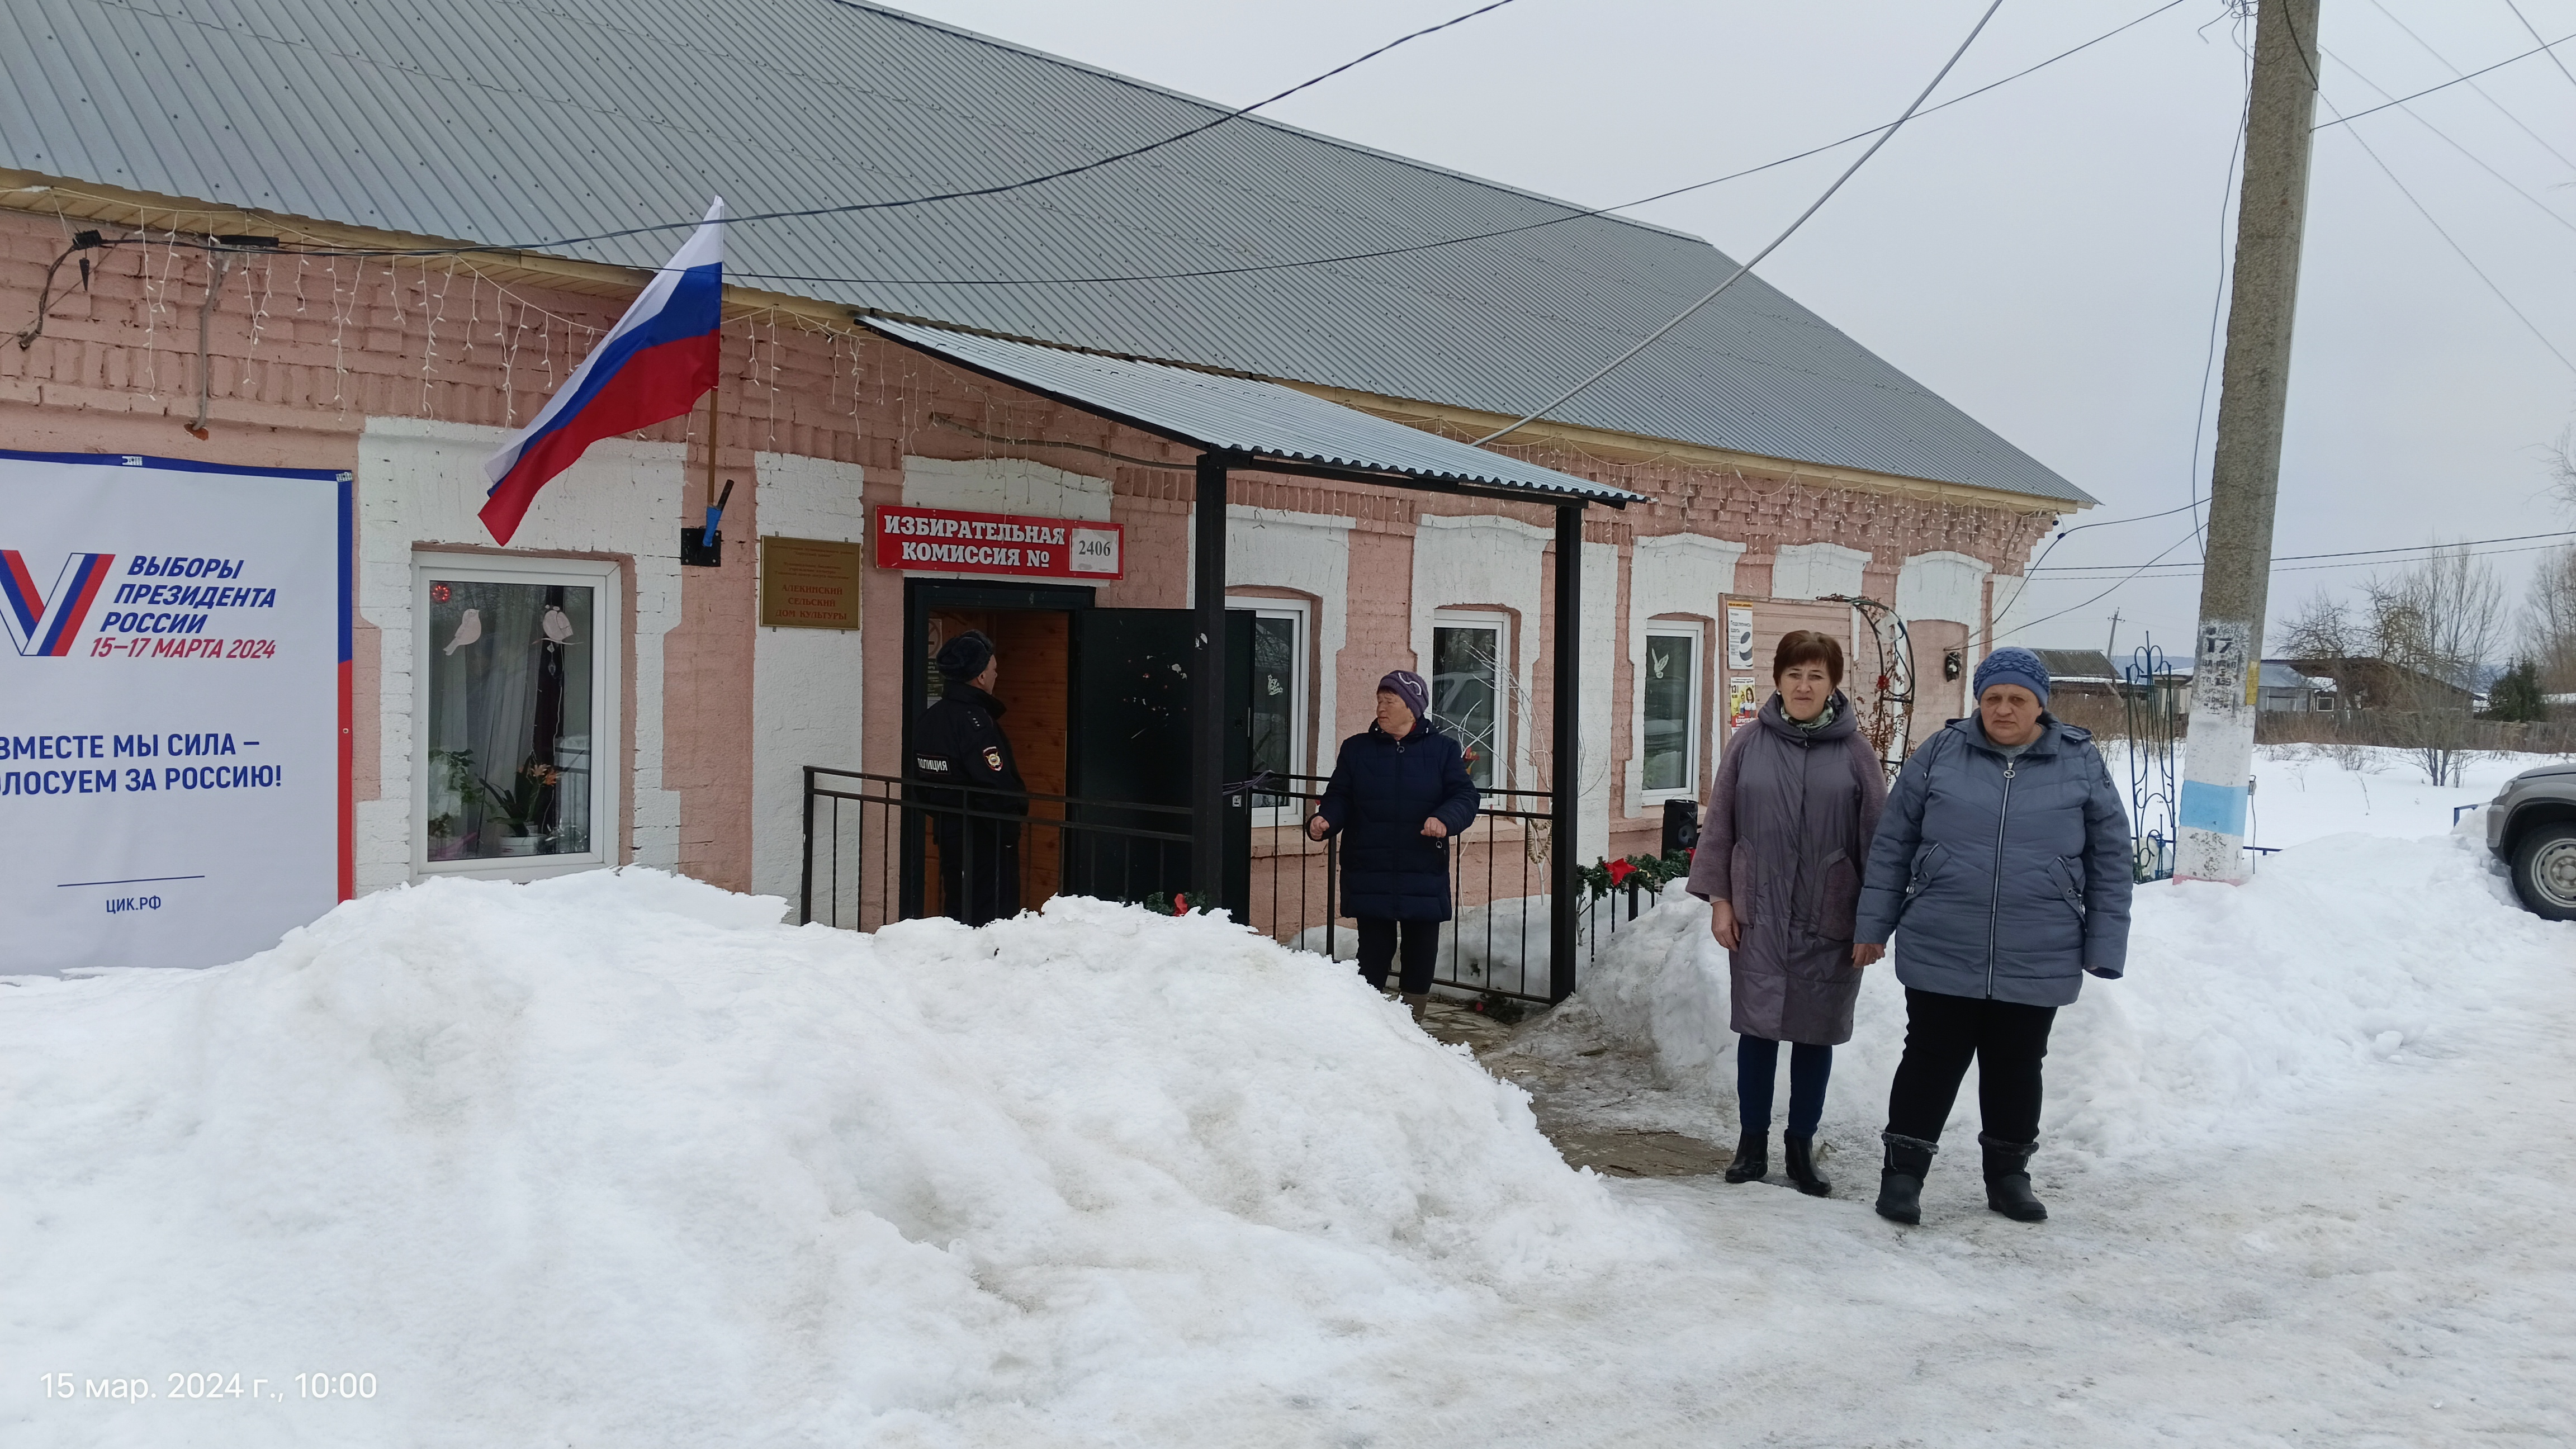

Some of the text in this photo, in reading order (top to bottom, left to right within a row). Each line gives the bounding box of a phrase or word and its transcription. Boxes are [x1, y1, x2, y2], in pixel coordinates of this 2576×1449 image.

[884, 515, 1066, 545] ИЗБИРАТЕЛЬНАЯ
[902, 542, 1050, 567] КОМИССИЯ №
[1078, 540, 1111, 556] 2406
[127, 555, 244, 579] ВЫБОРЫ
[113, 583, 276, 609] ПРЕЗИДЕНТА
[782, 584, 842, 595] АЛЕКИНСКИЙ
[788, 597, 836, 607] СЕЛЬСКИЙ
[100, 612, 209, 634] РОССИИ
[775, 609, 847, 621] ДОМ КУЛЬТУРЫ
[151, 638, 225, 659] МАРТА
[226, 639, 276, 659] 2024
[113, 734, 159, 757] МЫ
[168, 733, 236, 756] СИЛА
[0, 765, 281, 796] ЛОСУЕМ ЗА РОССИЮ!
[106, 895, 162, 915] ЦИК.РФ
